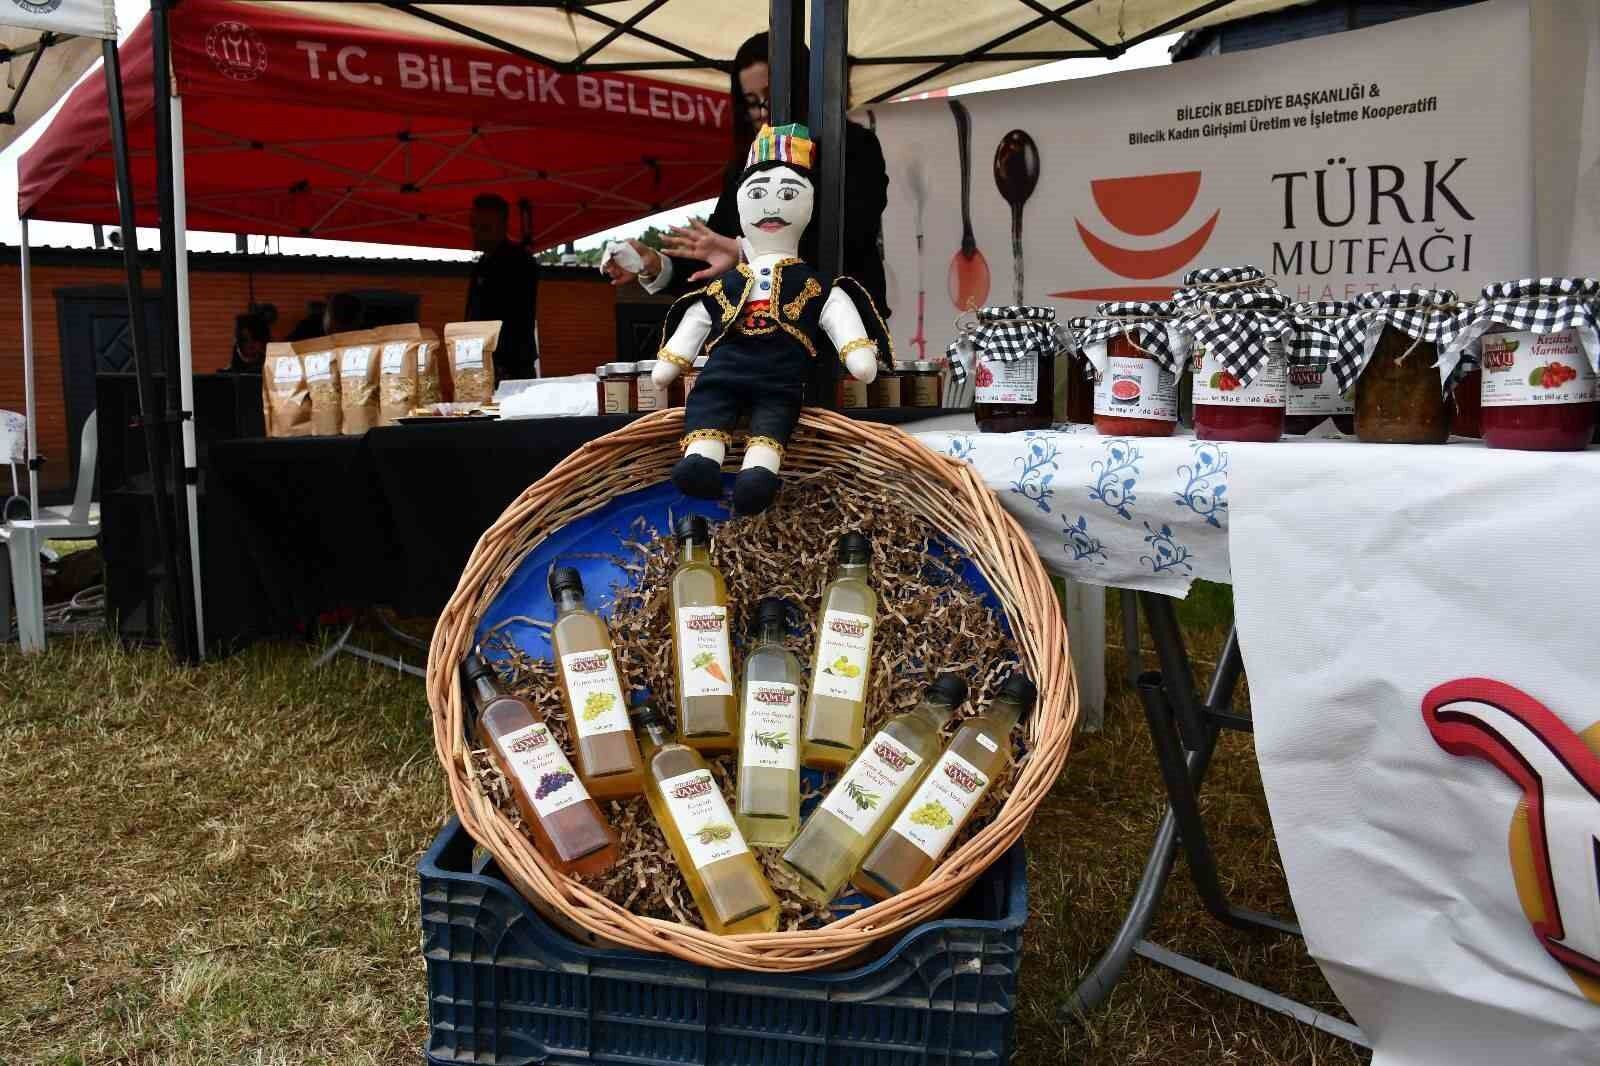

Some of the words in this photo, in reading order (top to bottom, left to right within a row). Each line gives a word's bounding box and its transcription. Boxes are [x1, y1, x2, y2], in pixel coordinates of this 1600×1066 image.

[296, 40, 383, 86] T.C.
[1128, 127, 1166, 145] Bilecik
[1168, 124, 1200, 141] Kadın
[1202, 119, 1248, 138] Girişimi
[1249, 116, 1290, 133] Üretim
[1293, 117, 1307, 127] ve
[1310, 108, 1359, 128] İşletme
[1361, 97, 1438, 121] Kooperatifi
[1176, 102, 1222, 121] BİLECİK
[1225, 95, 1283, 116] BELEDİYE
[1285, 83, 1365, 110] BAŞKANLIĞI
[1368, 83, 1381, 98] &
[1271, 156, 1476, 230] TÜRK
[1271, 226, 1474, 276] MUTFAĞI
